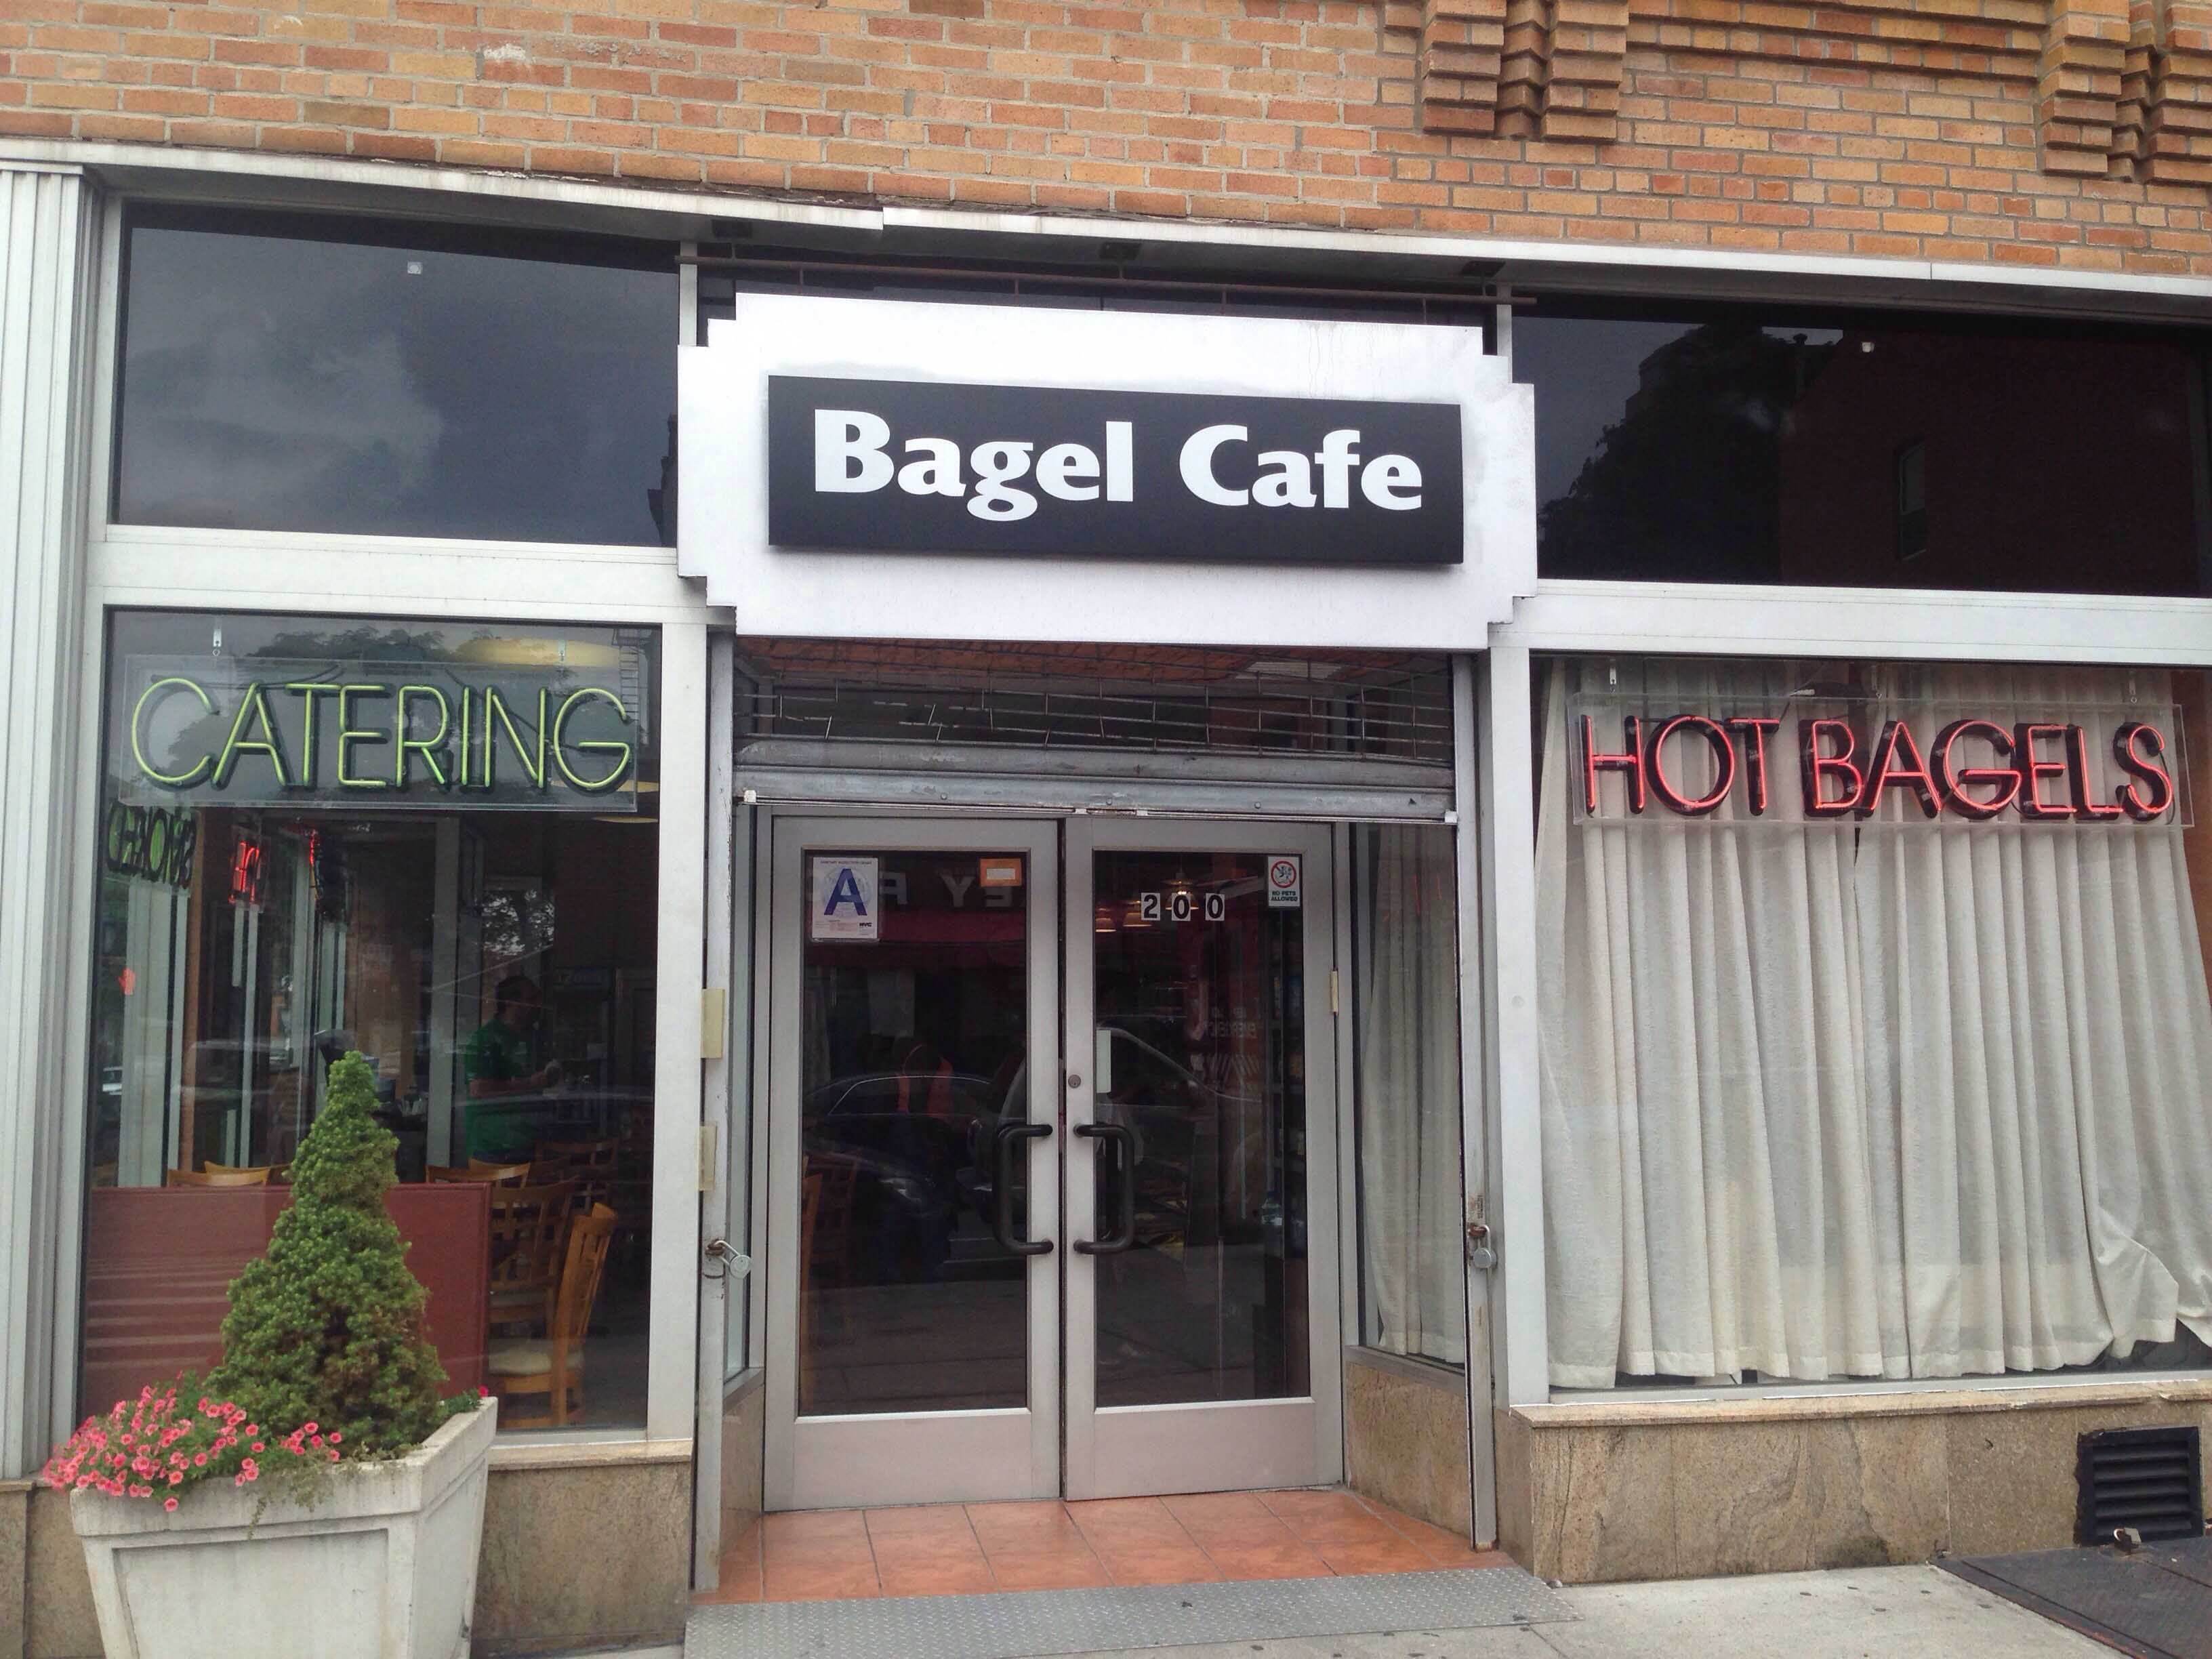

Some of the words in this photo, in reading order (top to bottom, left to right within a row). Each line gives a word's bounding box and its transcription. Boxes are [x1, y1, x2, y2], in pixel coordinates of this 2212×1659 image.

[813, 408, 1134, 523] Bagel
[1179, 424, 1422, 511] Cafe
[130, 678, 633, 791] CATERING
[1580, 714, 1780, 816] HOT
[1797, 718, 2172, 820] BAGELS
[823, 867, 868, 916] A
